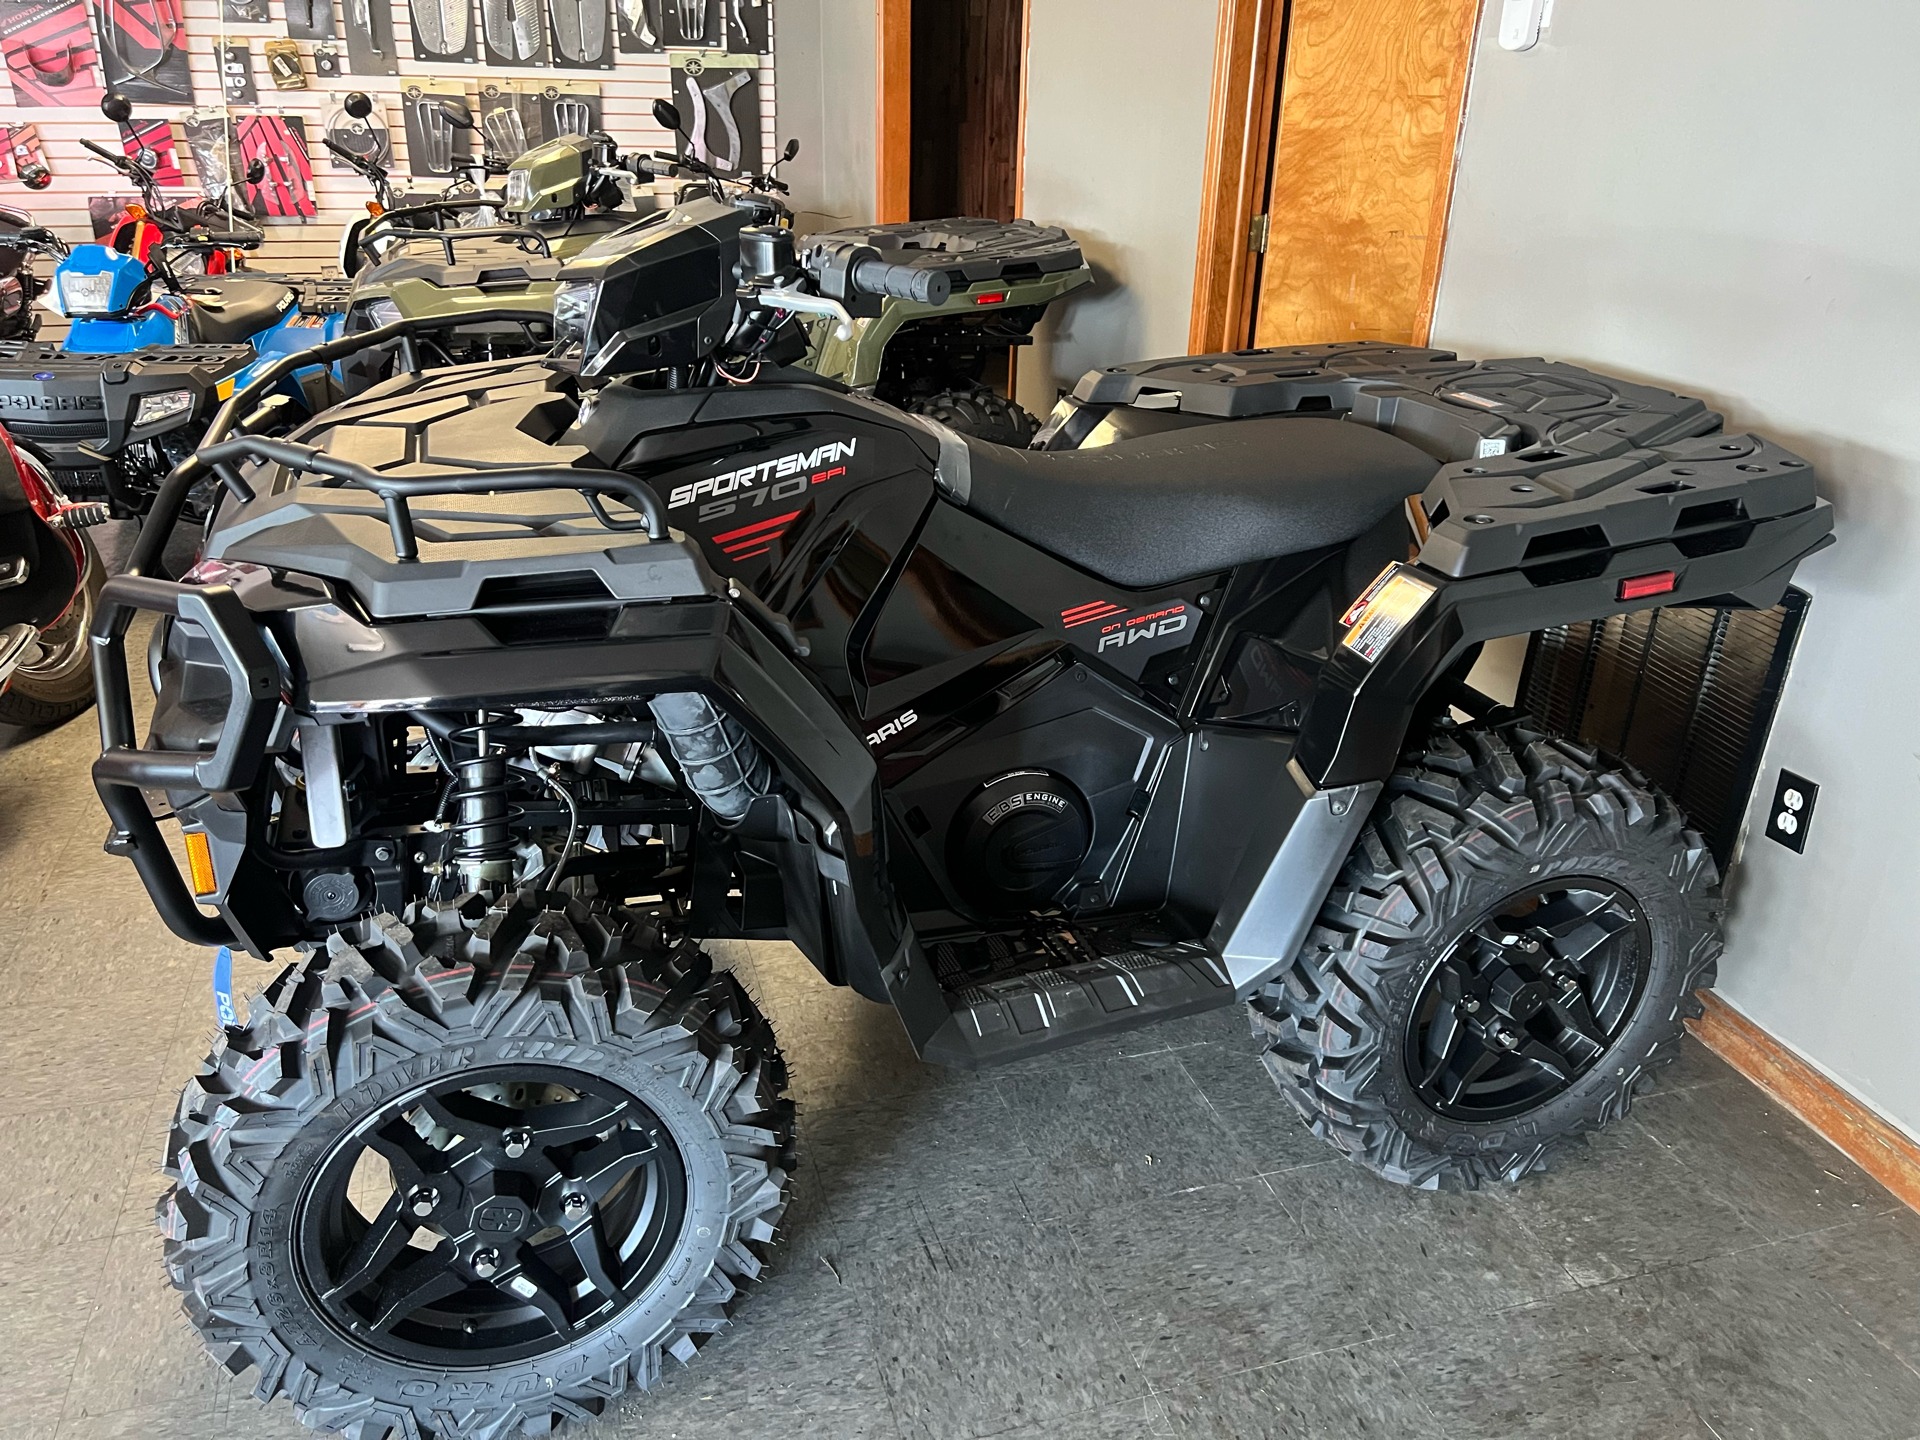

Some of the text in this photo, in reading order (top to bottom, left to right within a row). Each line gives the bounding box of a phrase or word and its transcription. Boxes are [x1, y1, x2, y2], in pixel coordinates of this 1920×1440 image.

[7, 4, 44, 23] HONDA
[0, 395, 103, 411] POLARIS
[667, 437, 857, 510] SPORTSMAN
[698, 466, 846, 523] 570 EFI
[1097, 614, 1188, 653] AWD
[986, 793, 1024, 823] EBS
[1025, 793, 1066, 808] ENGINE
